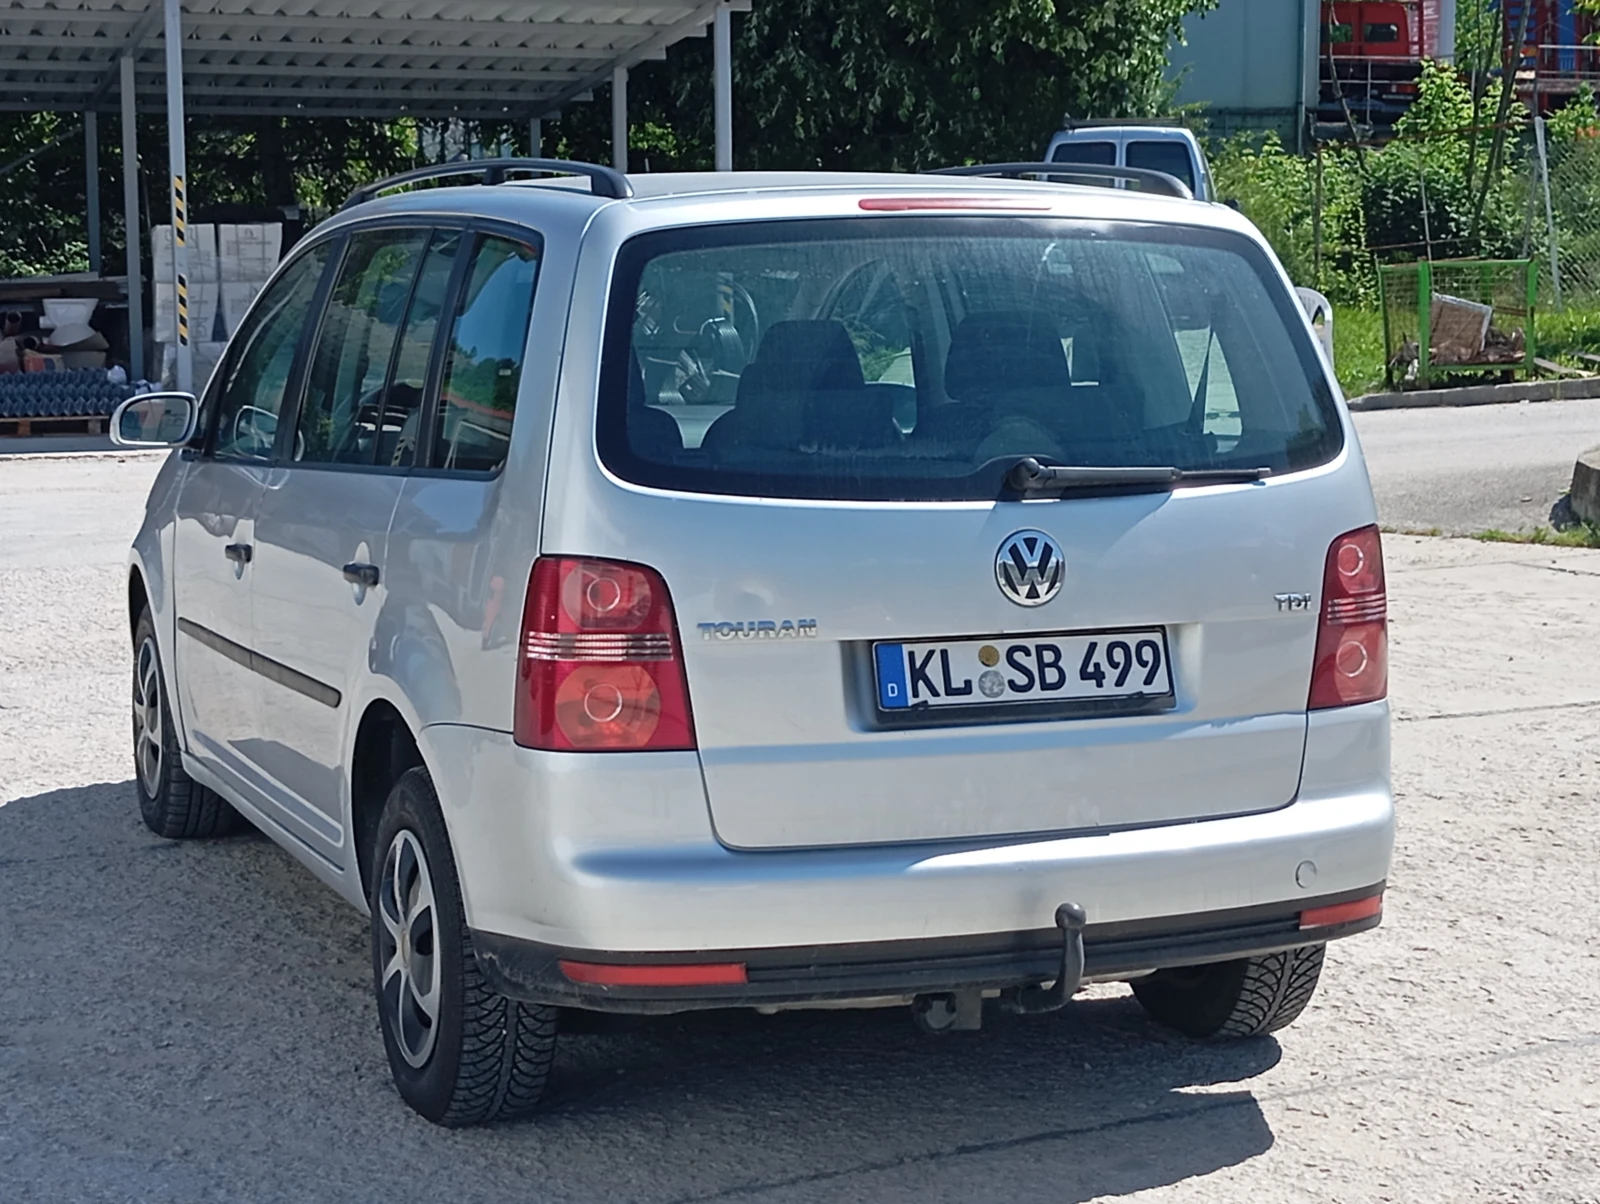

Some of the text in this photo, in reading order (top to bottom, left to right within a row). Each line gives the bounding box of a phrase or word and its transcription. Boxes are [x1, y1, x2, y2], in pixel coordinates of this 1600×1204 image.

[697, 618, 817, 641] TOURAN
[908, 639, 1161, 698] KL SB 499
[887, 683, 898, 697] D
